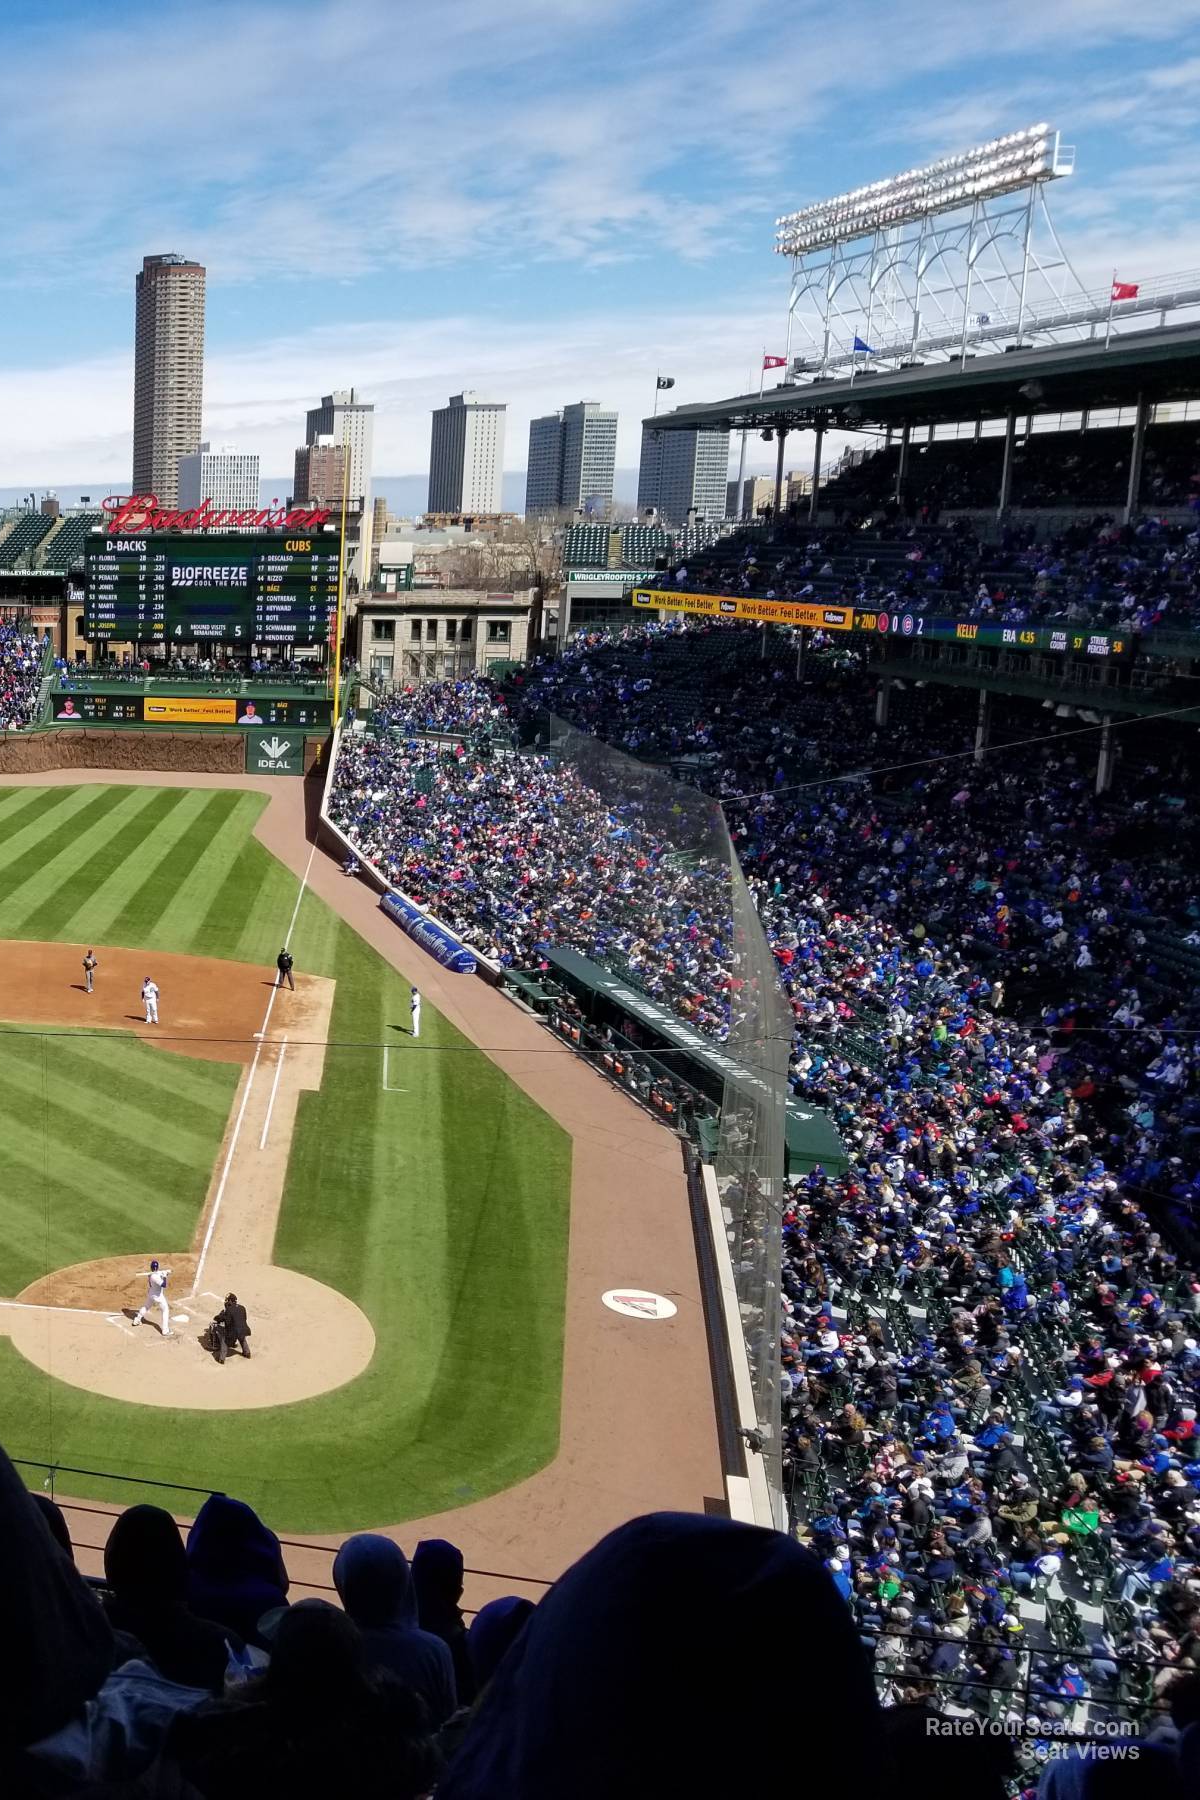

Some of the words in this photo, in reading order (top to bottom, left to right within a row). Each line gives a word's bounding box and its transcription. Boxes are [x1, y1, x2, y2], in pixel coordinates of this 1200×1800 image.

[102, 493, 330, 533] Budweiser
[106, 541, 146, 551] D-BACKS
[285, 540, 311, 551] CUBS
[654, 596, 666, 605] Work
[667, 596, 683, 607] Better.
[685, 598, 695, 608] Feel
[696, 599, 714, 609] Better.
[741, 603, 756, 614] Work
[758, 605, 779, 616] Better.
[780, 607, 794, 618] Feel
[795, 609, 818, 620] Better.
[175, 625, 182, 636] 4
[861, 614, 876, 629] 2ND
[893, 616, 898, 632] 0
[917, 618, 923, 634] 2
[235, 626, 242, 636] 5
[956, 624, 978, 639] KELLY
[1003, 629, 1016, 642] ERA
[1020, 631, 1035, 643] 4.35
[1052, 632, 1066, 641] PITCH
[1090, 636, 1108, 645] STRIKE
[1050, 641, 1067, 650] COUNT
[1074, 638, 1082, 648] 57
[1087, 645, 1110, 655] PERCENT
[1113, 641, 1123, 653] 58
[258, 760, 291, 768] IDEAL
